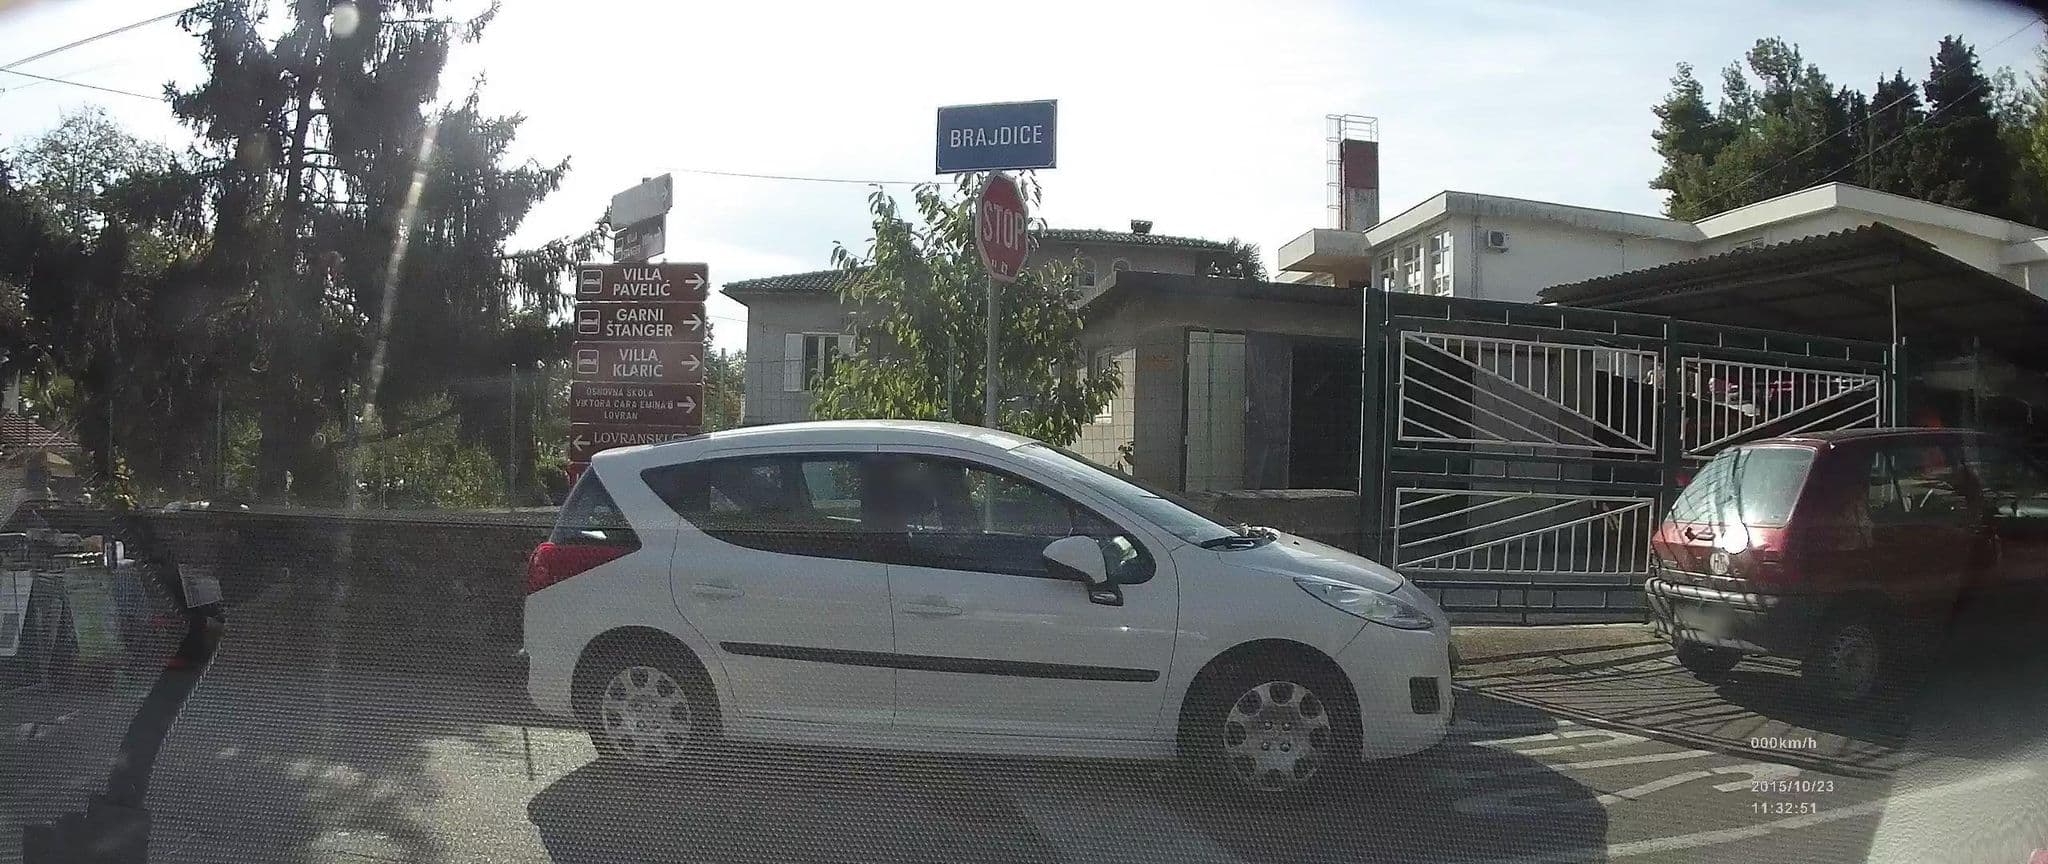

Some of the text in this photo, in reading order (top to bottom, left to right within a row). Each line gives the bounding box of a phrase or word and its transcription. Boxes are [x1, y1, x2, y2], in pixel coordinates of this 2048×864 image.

[950, 125, 1042, 148] BRAJDICE
[983, 199, 1025, 251] STOP
[623, 268, 662, 281] VILLA
[613, 279, 671, 296] PAVELIĆ
[616, 308, 664, 321] GARNI
[606, 319, 673, 337] ŠTANGER
[619, 348, 658, 361] VILLA
[613, 360, 663, 377] KLARIĆ
[576, 399, 611, 408] VIKTORA
[613, 400, 637, 408] CARA
[604, 411, 638, 420] LOVRAN
[594, 431, 669, 445] LOVRANSKI
